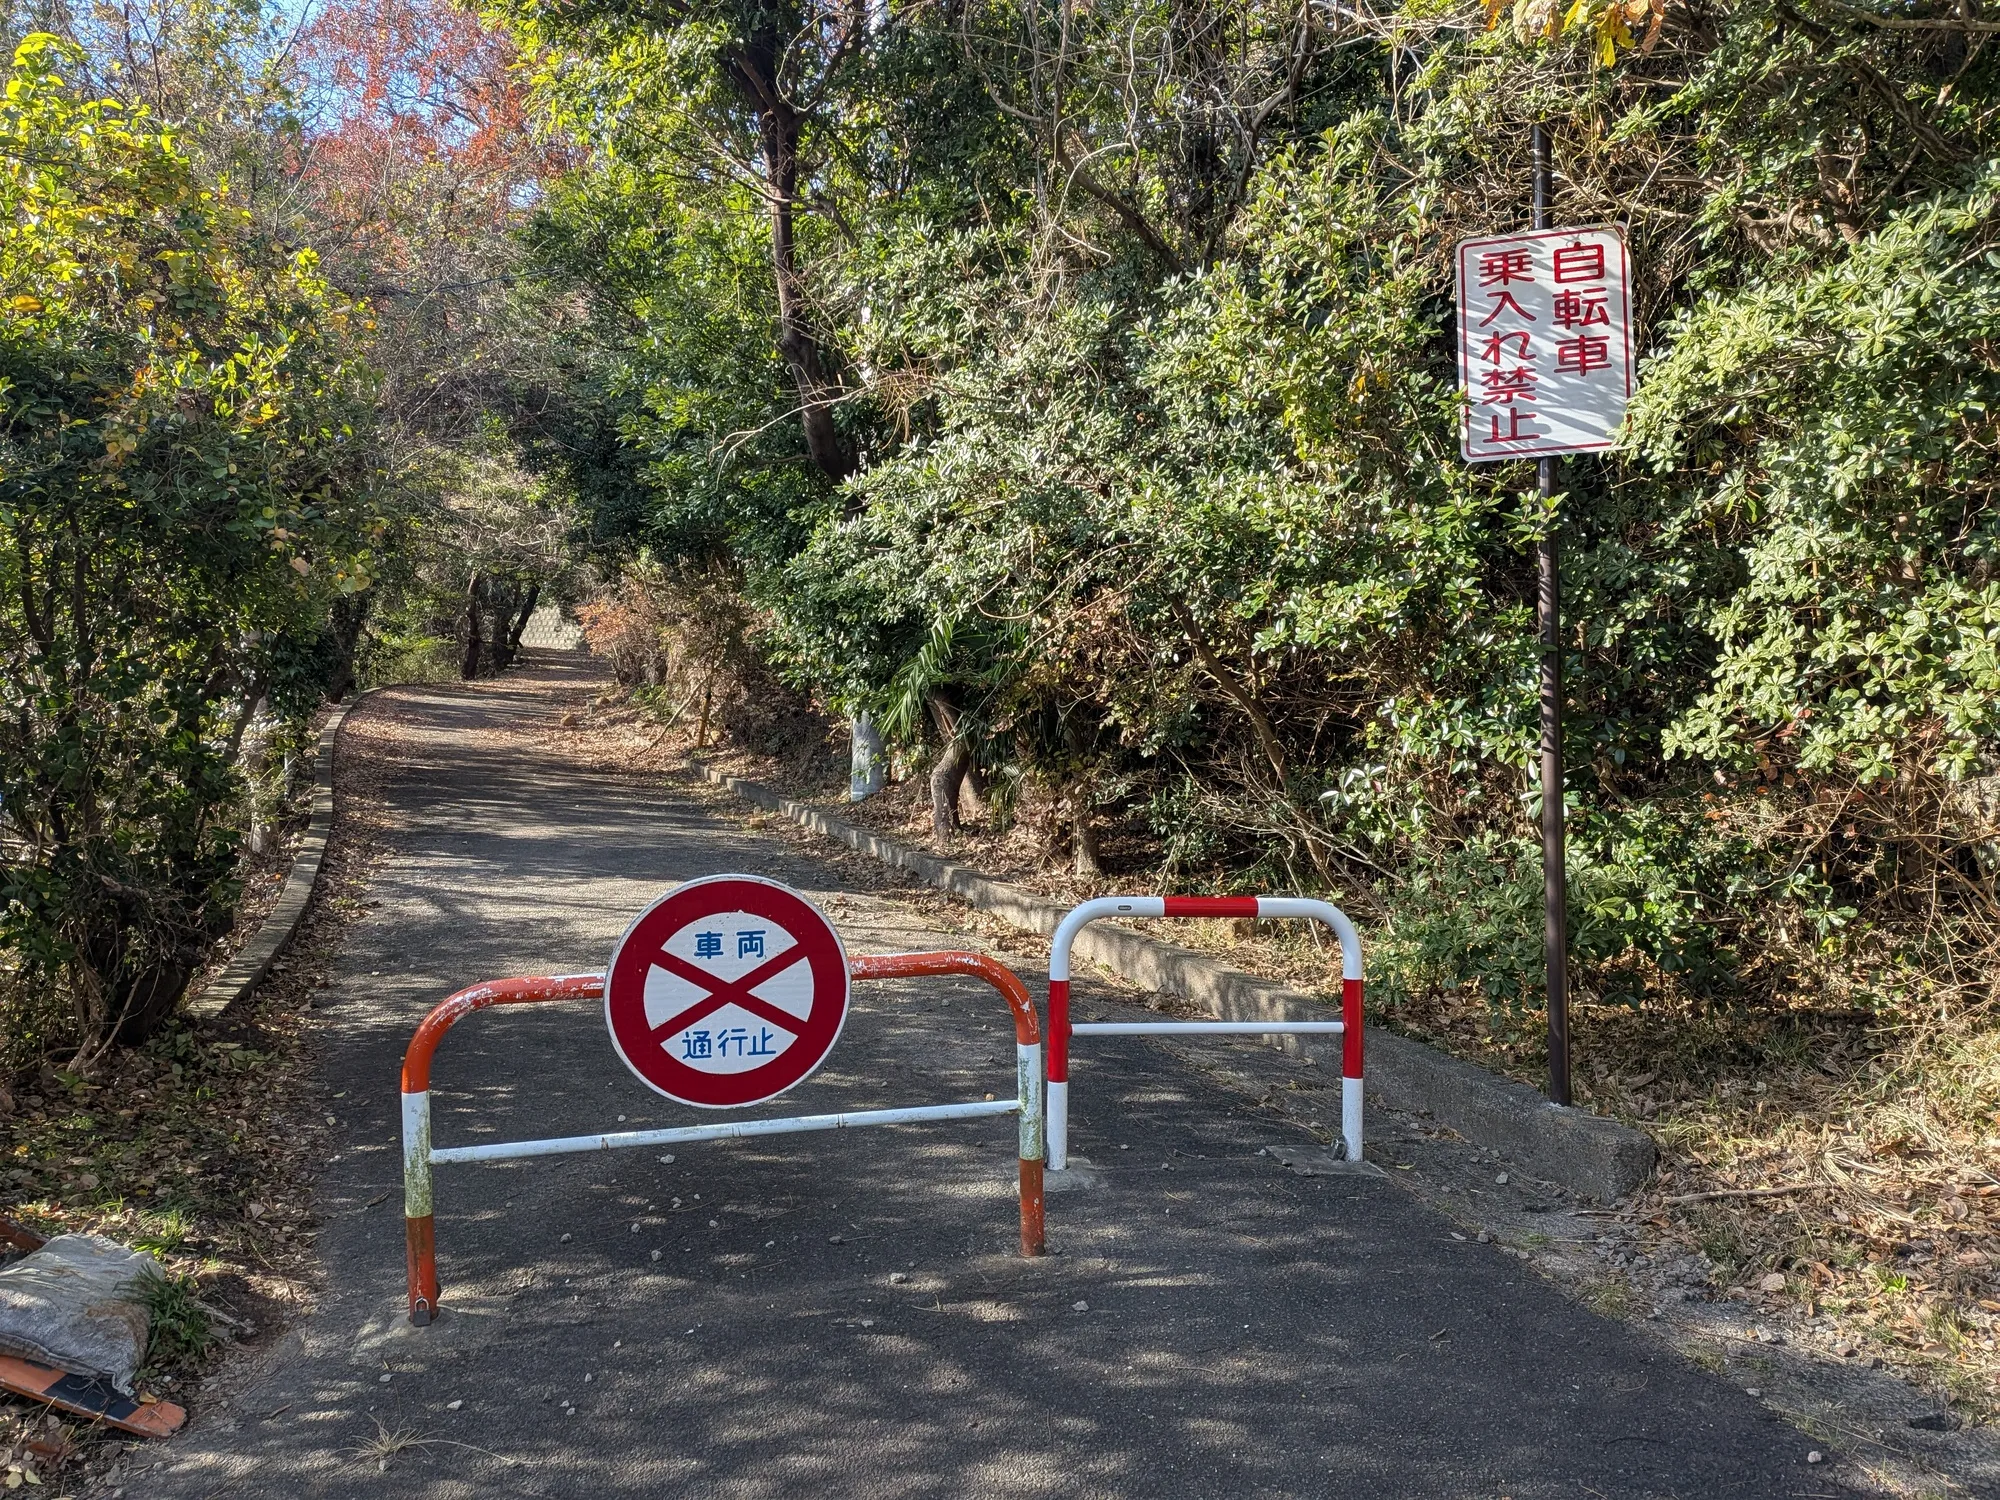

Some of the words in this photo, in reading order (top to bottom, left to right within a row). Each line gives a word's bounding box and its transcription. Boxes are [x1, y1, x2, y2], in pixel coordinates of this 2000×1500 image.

[1478, 247, 1541, 444] 乗入れ禁止
[1552, 241, 1612, 377] 自転車
[693, 930, 767, 960] 車両
[681, 1026, 777, 1060] 通行止
